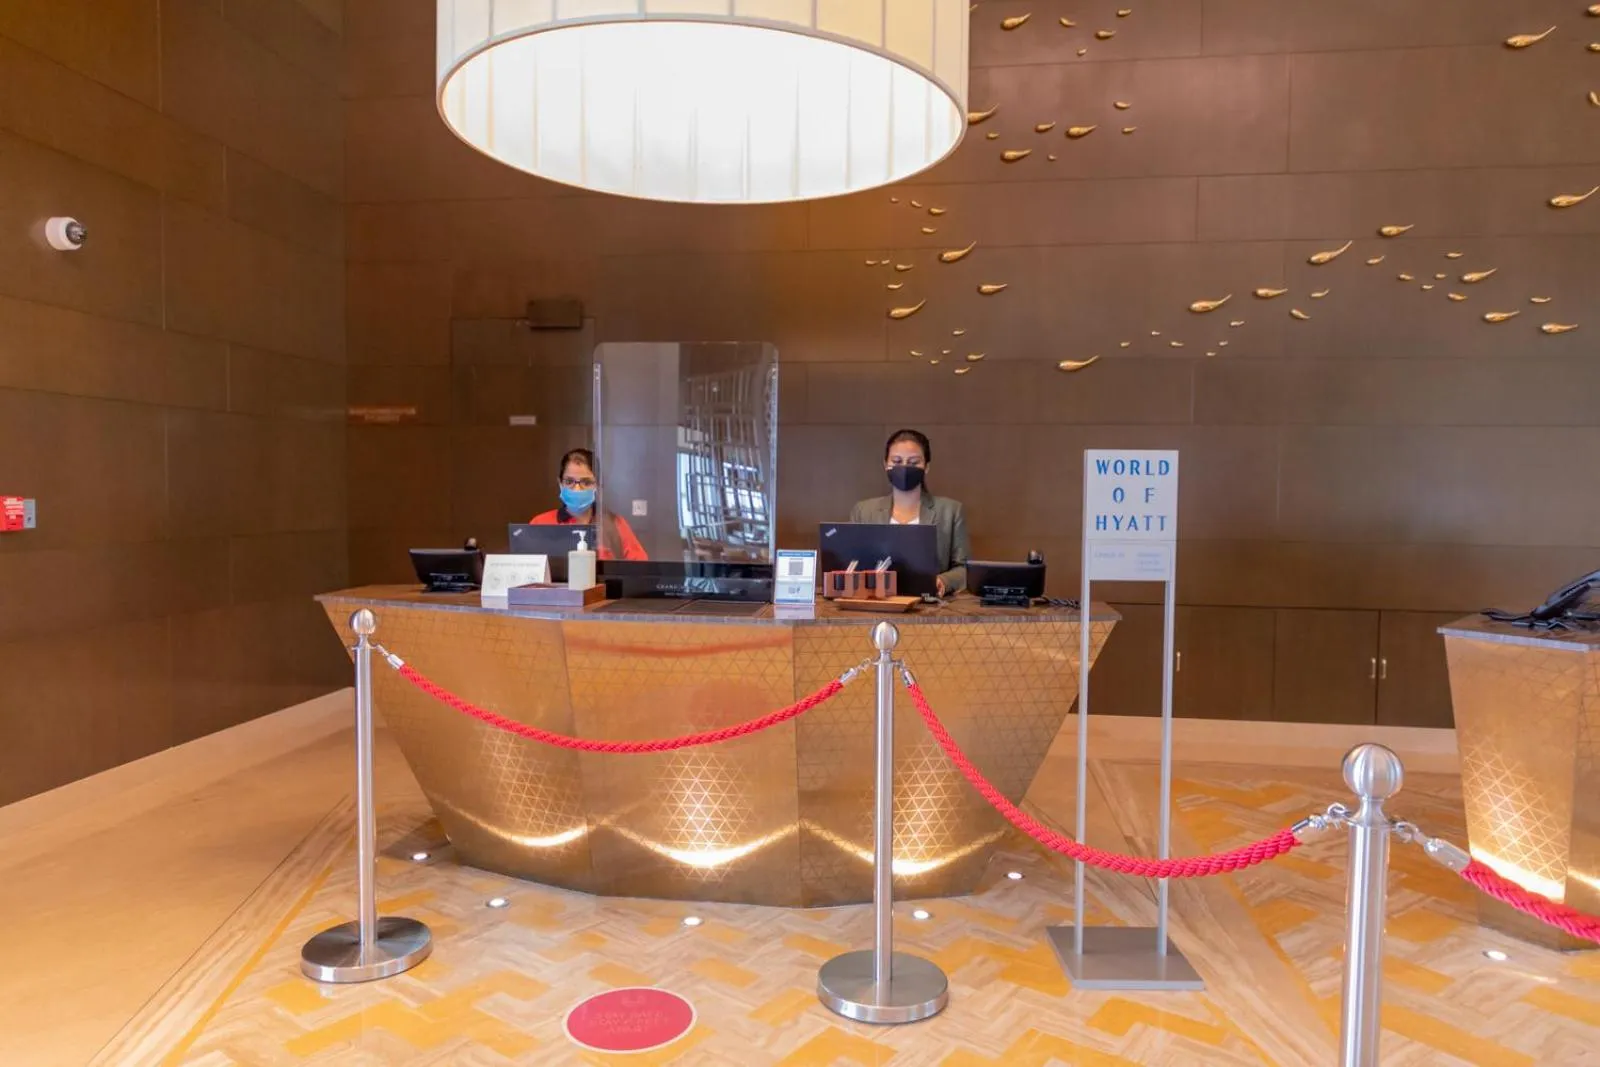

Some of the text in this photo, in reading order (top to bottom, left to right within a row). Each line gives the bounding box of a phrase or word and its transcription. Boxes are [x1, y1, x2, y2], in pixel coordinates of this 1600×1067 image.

[1096, 459, 1170, 476] WORLD
[1112, 487, 1155, 503] OF
[1095, 515, 1167, 531] HYATT
